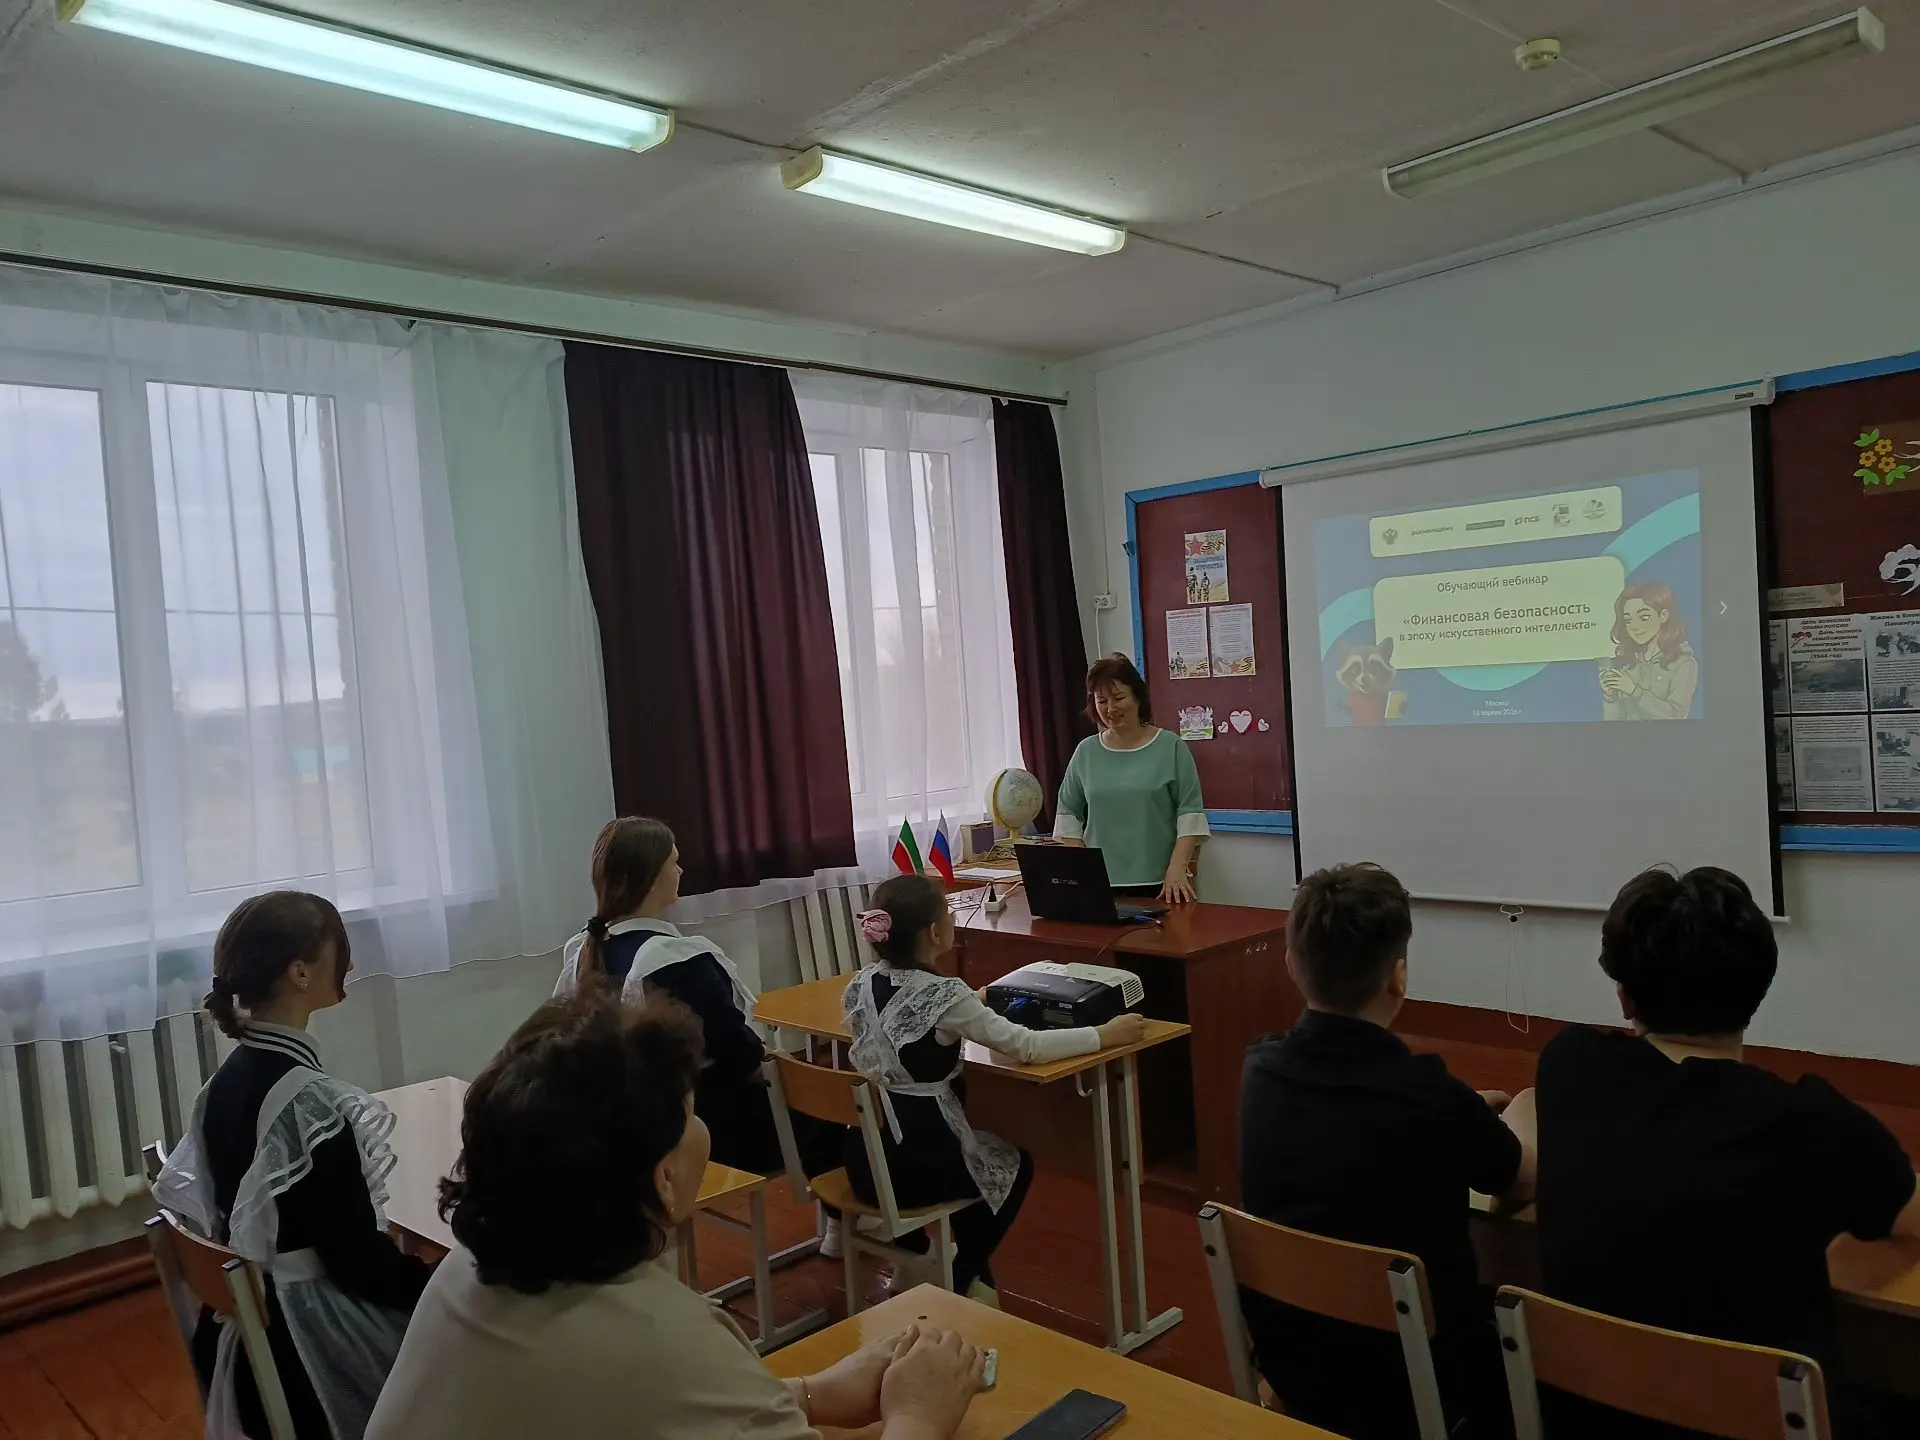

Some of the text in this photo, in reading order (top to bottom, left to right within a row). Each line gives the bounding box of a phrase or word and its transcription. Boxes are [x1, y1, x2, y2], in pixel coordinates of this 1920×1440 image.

[1437, 574, 1549, 594] Обучающий вебинар
[1403, 602, 1591, 626] «Финансовая безопасность
[1399, 620, 1597, 643] в эпоху искусственного интеллекта»
